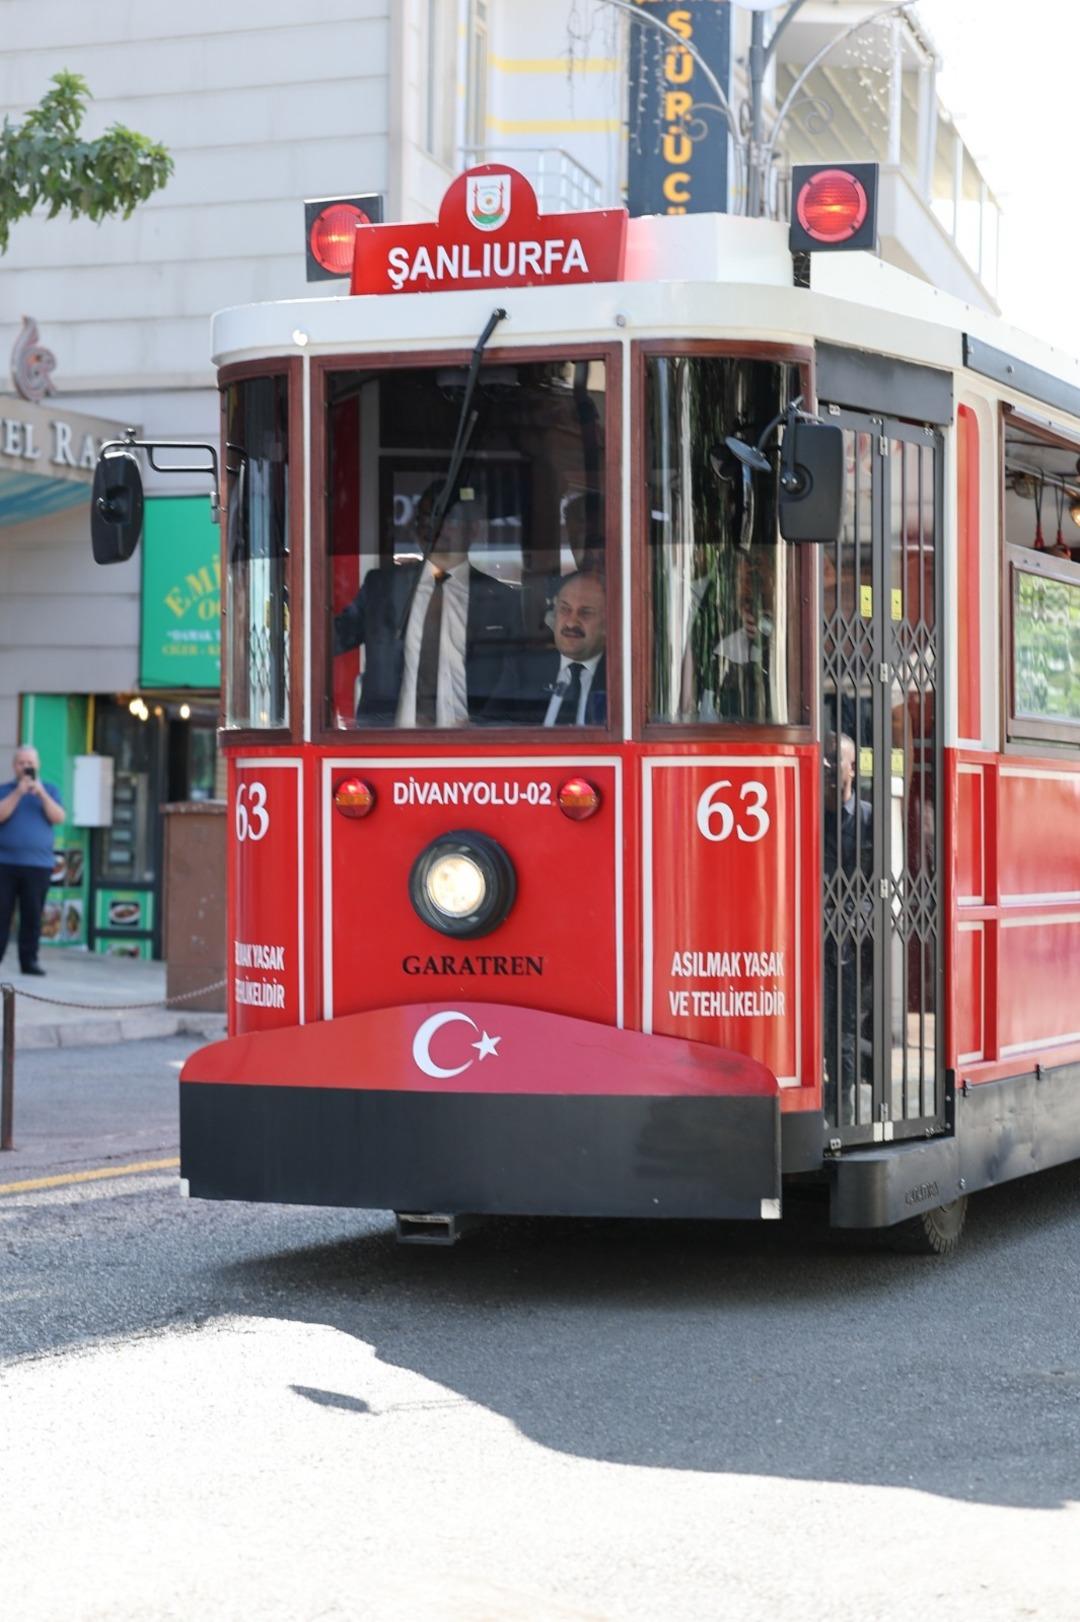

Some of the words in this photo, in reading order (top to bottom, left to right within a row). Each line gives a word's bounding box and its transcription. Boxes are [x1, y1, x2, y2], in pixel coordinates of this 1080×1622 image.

[663, 9, 694, 216] SÜRÜC
[387, 238, 589, 290] ŞANLIURFA
[393, 777, 551, 806] DİVANYOLU-02
[236, 781, 270, 842] 63
[696, 780, 770, 842] 63
[253, 944, 285, 971] YASAK
[402, 956, 544, 976] GARATREN
[671, 951, 742, 977] ASILMAK
[743, 951, 785, 977] YASAK
[669, 991, 689, 1016] VE
[691, 985, 786, 1016] TEHLİKELİDİR
